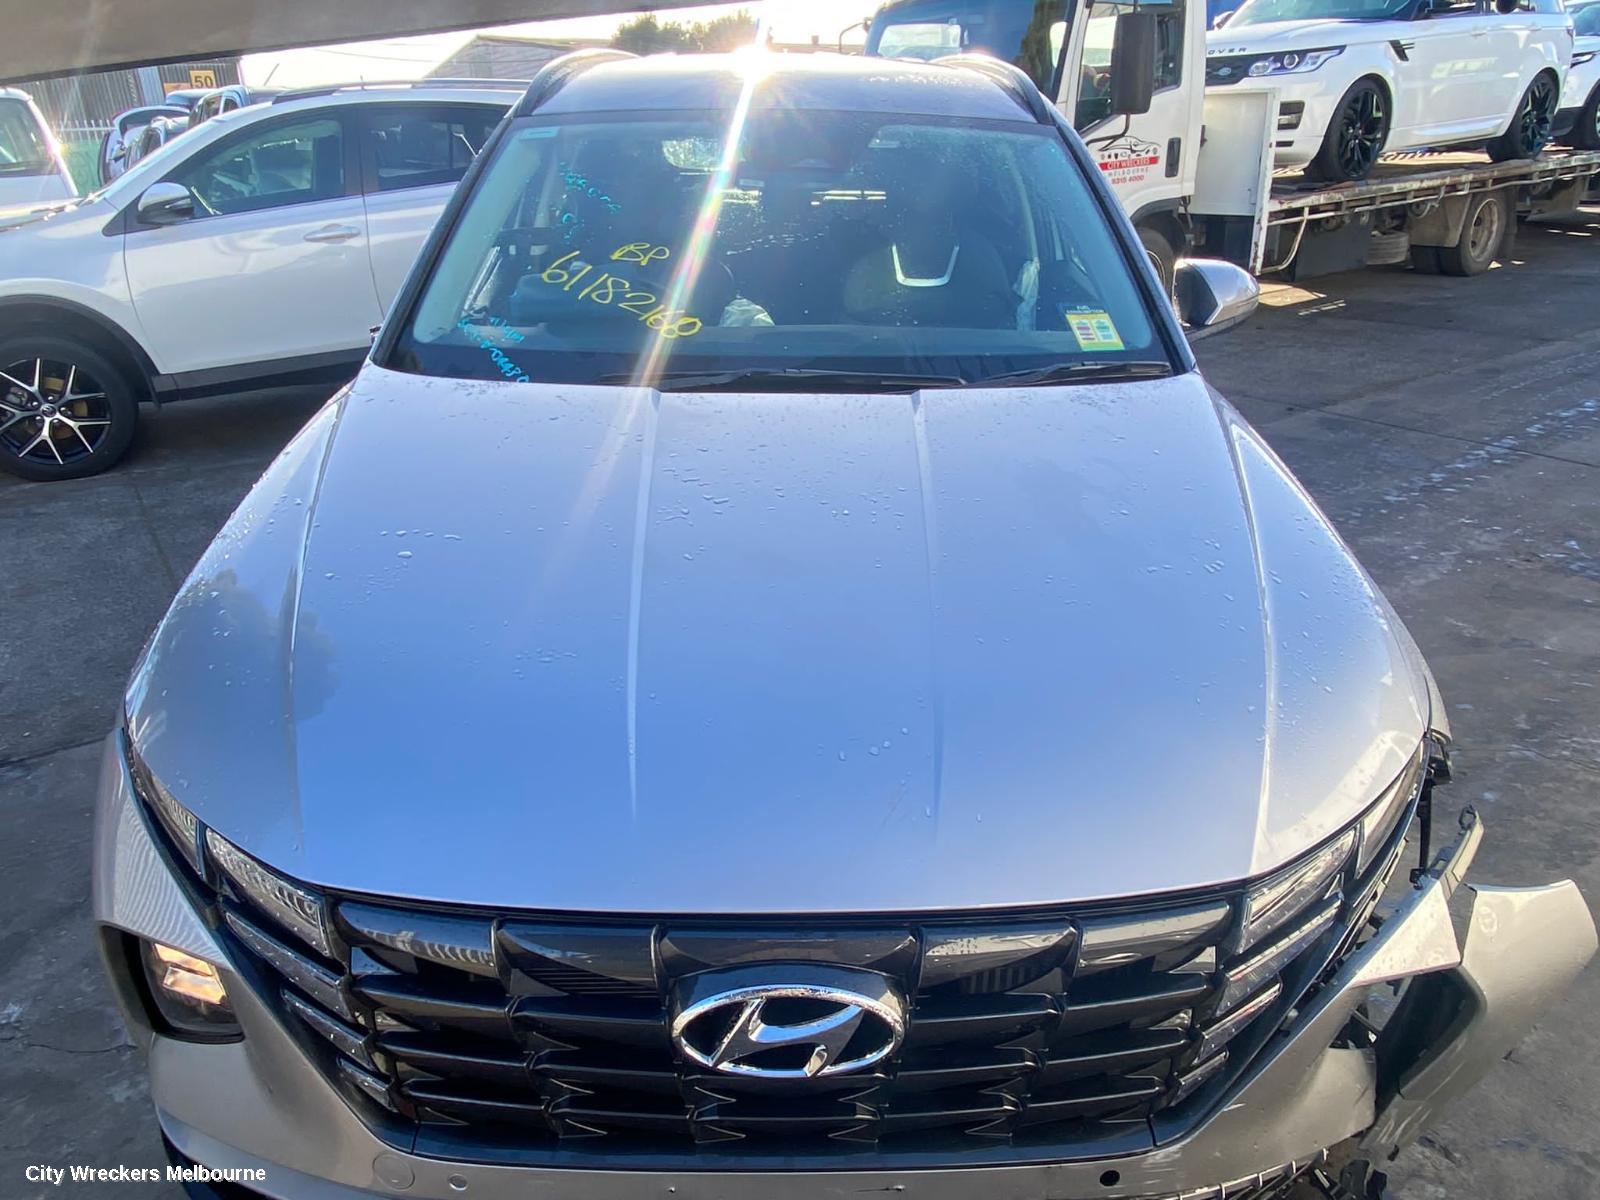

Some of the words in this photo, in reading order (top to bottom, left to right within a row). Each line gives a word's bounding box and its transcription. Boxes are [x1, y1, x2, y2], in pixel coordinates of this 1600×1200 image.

[194, 75, 213, 88] 50
[1107, 160, 1120, 169] CITY
[1121, 157, 1150, 168] WRECKERS
[1108, 167, 1149, 176] MELBOURNE
[1128, 175, 1145, 183] 4000
